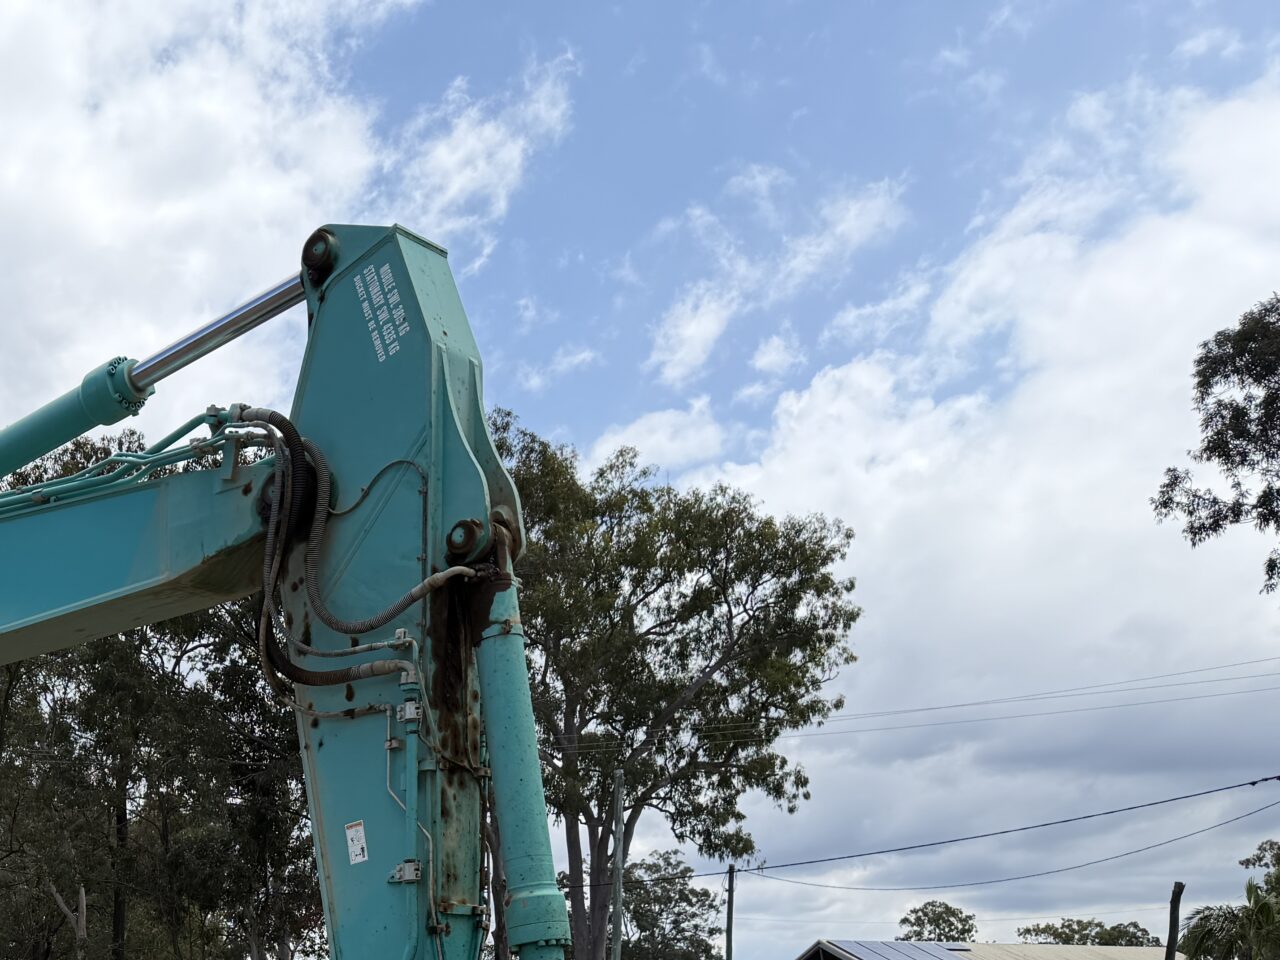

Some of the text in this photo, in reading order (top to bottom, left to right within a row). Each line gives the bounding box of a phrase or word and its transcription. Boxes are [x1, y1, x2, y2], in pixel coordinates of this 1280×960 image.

[353, 274, 386, 363] BUCKET MUST BE REMOVED
[363, 264, 400, 356] STATIONARY SWL 4335 KG
[379, 263, 395, 292] MOBILE
[387, 288, 400, 308] SWL
[397, 321, 410, 337] KG
